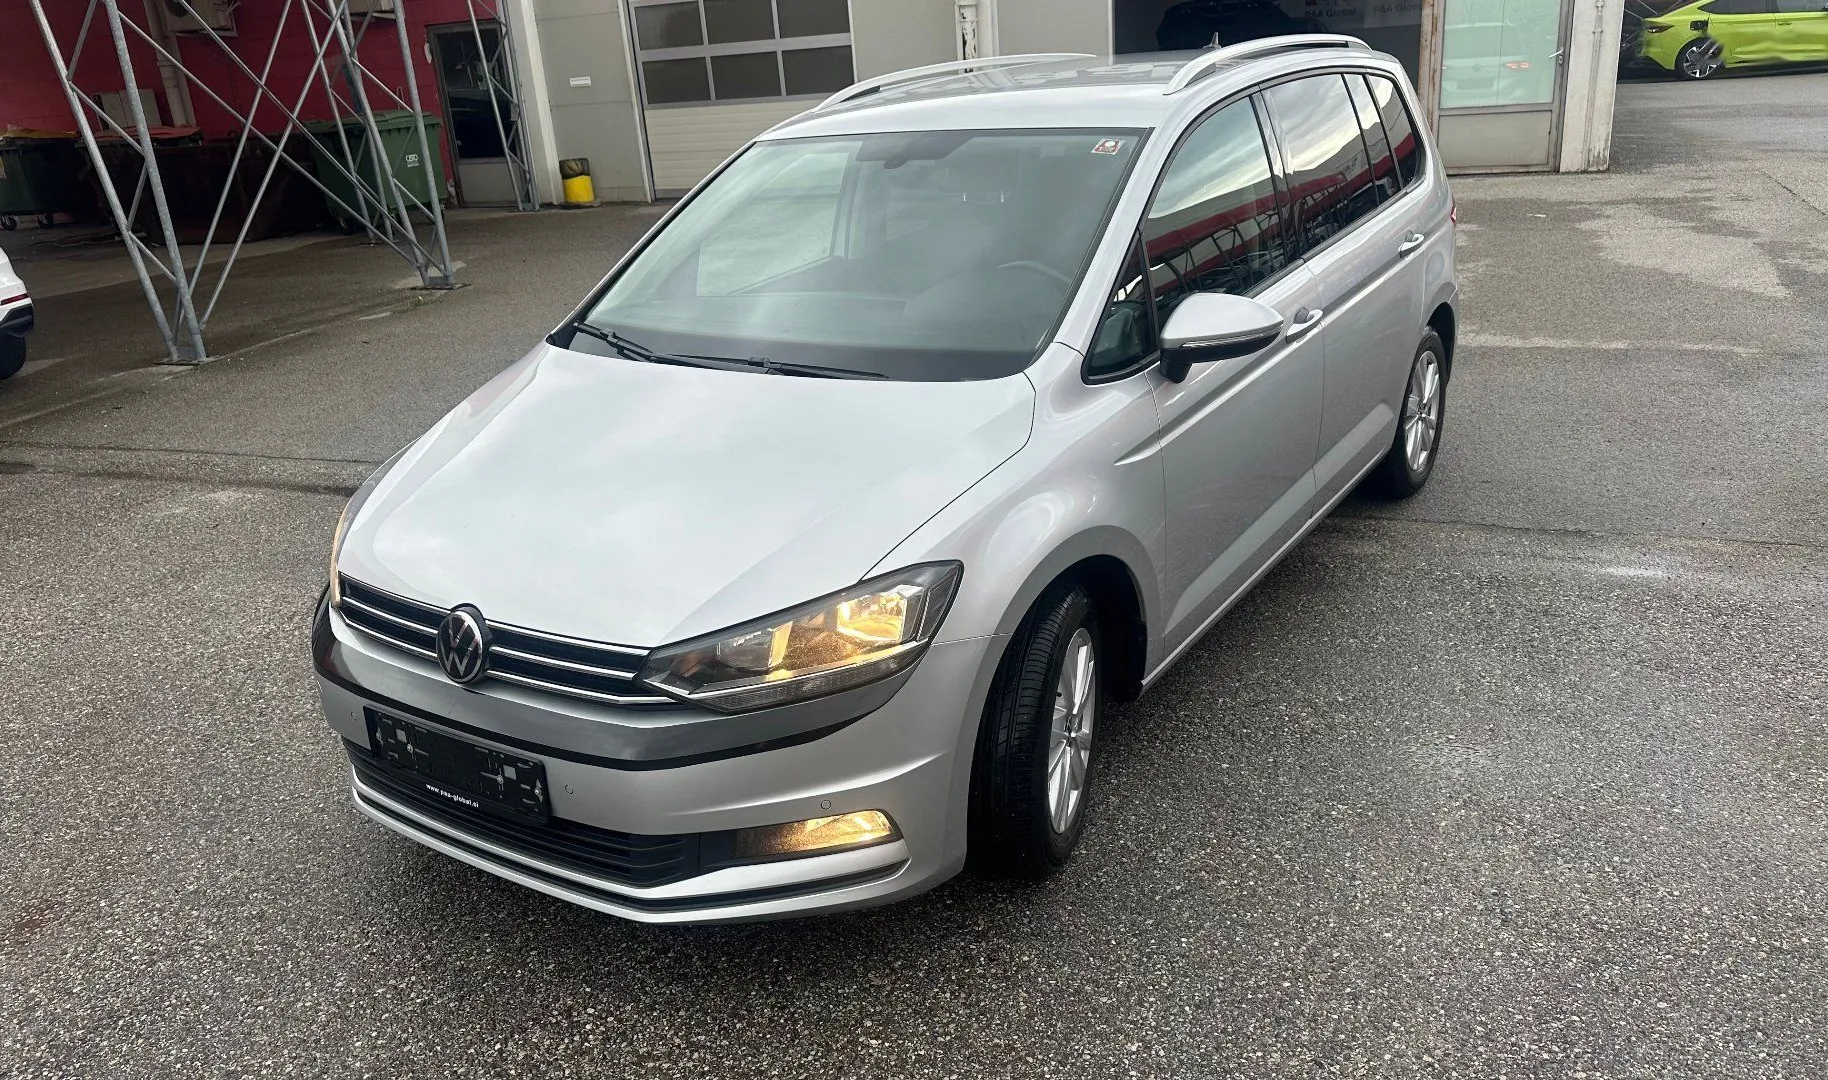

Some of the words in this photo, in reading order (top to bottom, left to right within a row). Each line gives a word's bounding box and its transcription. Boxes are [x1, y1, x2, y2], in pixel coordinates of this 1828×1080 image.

[1326, 8, 1356, 18] Global
[438, 611, 482, 682] VW
[425, 783, 479, 808] www.paa-global.si
